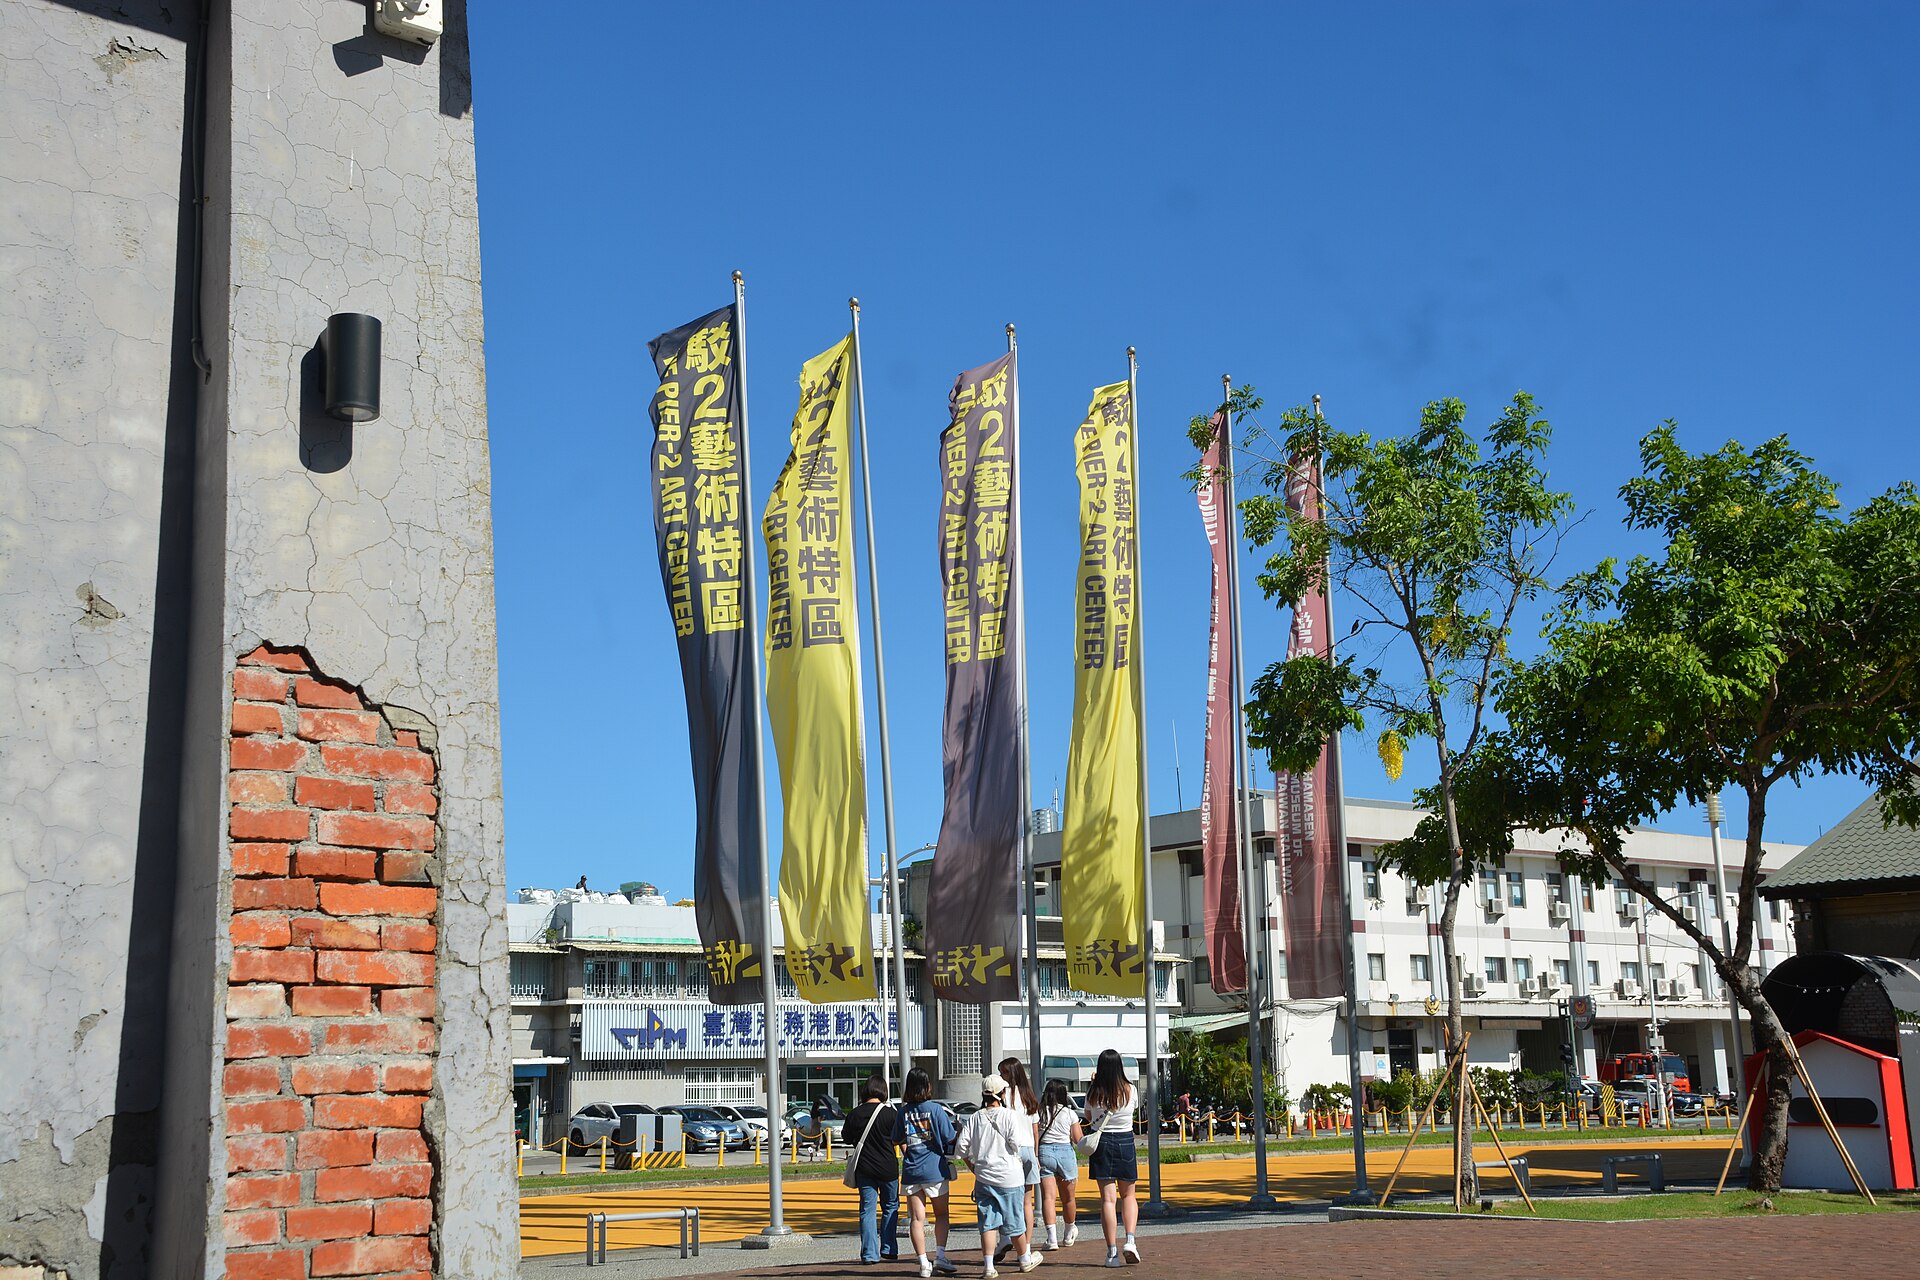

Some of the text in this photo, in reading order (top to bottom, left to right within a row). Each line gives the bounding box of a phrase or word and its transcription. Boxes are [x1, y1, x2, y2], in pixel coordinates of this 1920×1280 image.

[656, 382, 682, 471] PIER-2
[946, 421, 968, 507] PIER-2
[659, 476, 688, 525] ART
[685, 321, 744, 635] 駁2藝術特區
[1082, 438, 1108, 516] PIER-2
[945, 513, 967, 561] ART
[1080, 523, 1107, 571] ART
[666, 523, 693, 639] CENTER
[769, 549, 793, 651] CENTER
[947, 568, 971, 665] CENTER
[1084, 577, 1107, 672] CENTER
[1278, 773, 1294, 897] TAIWAN RAILWAY
[1290, 773, 1303, 857] MUSEUM OF
[1302, 771, 1315, 841] HAMASEN
[703, 1038, 733, 1047] TIPC
[739, 1037, 786, 1047] Mare
[793, 1036, 875, 1048] Corporation,
